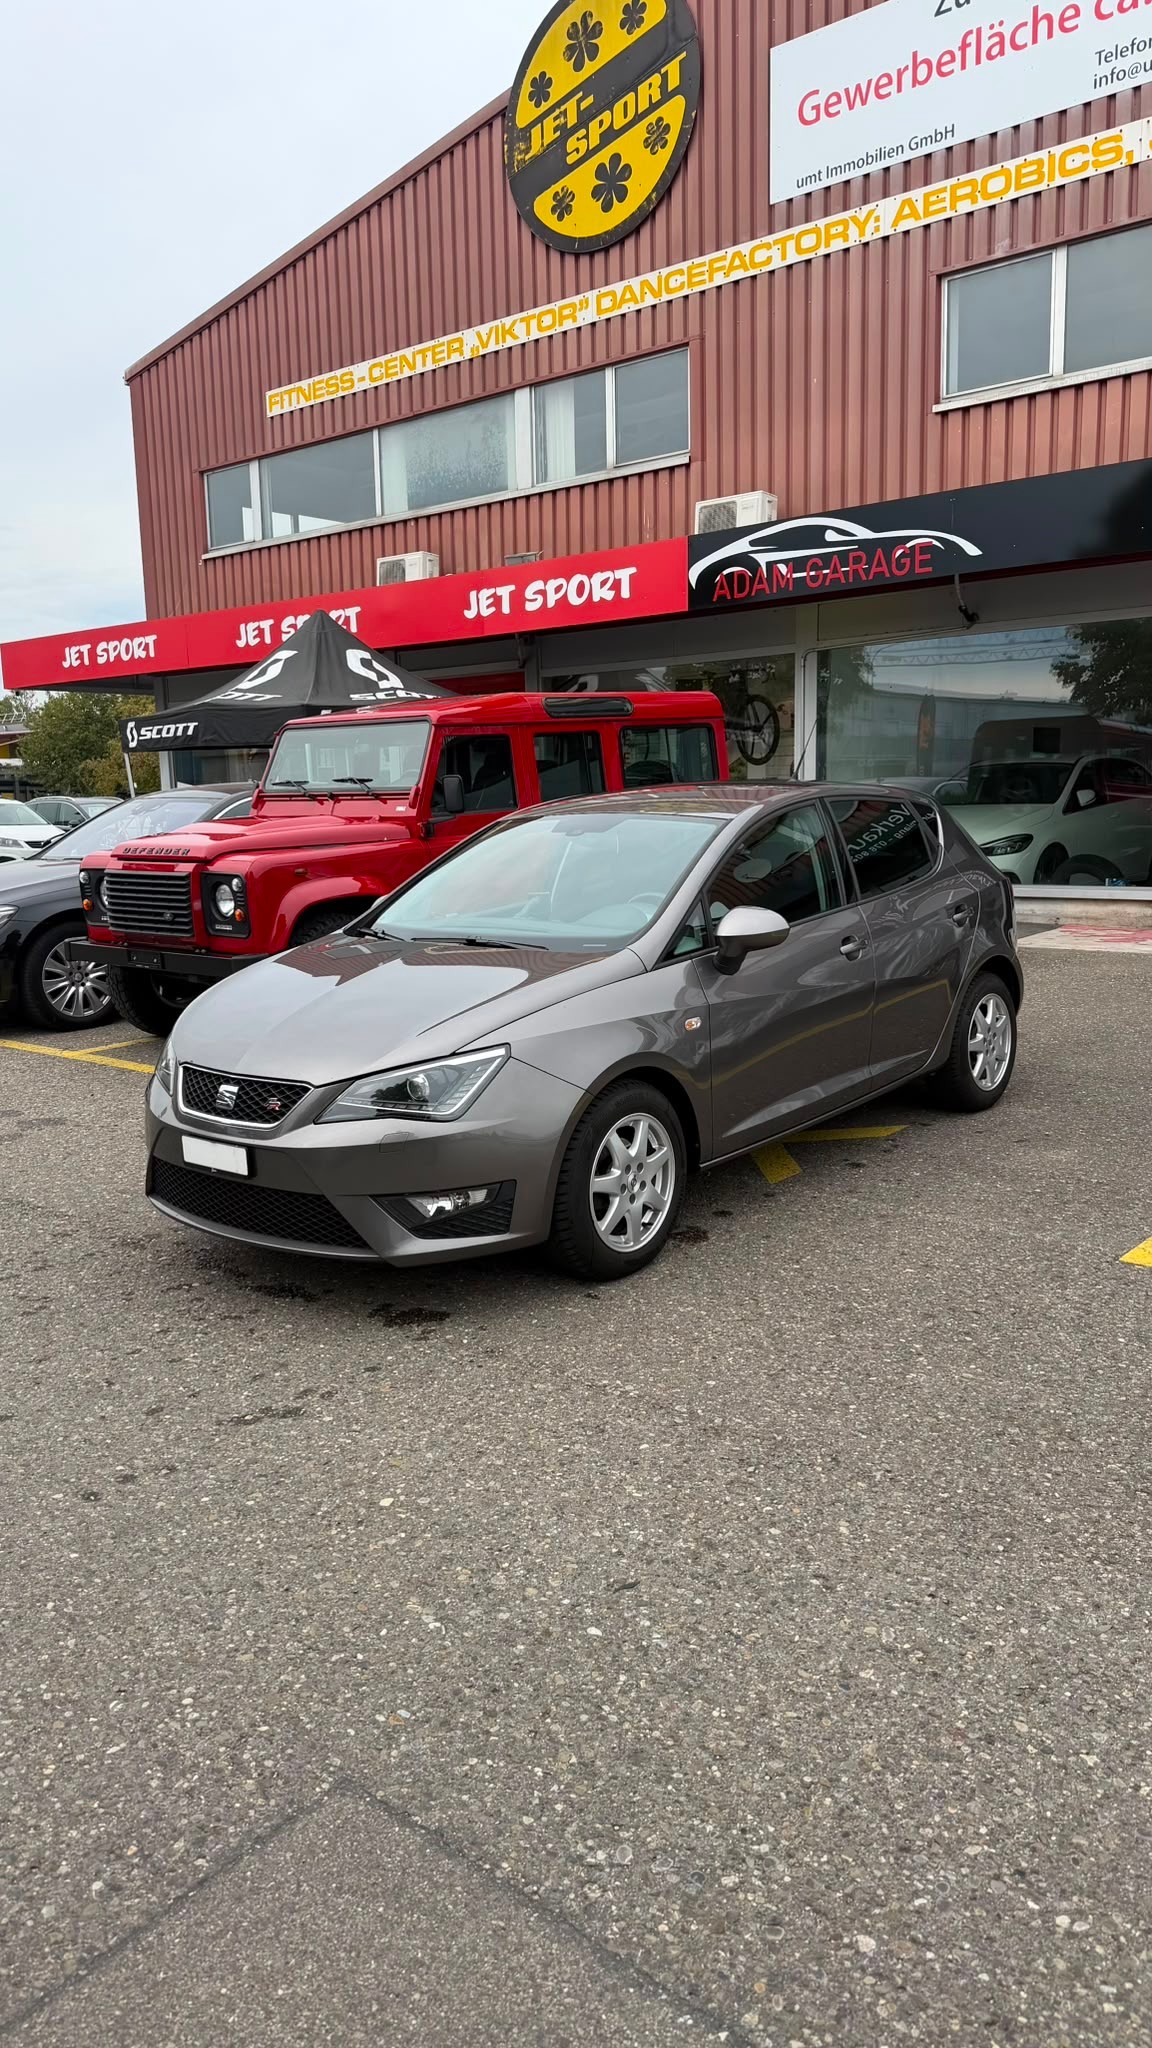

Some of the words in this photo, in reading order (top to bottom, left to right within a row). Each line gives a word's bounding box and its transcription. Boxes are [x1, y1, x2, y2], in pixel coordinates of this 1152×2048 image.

[797, 3, 1081, 126] Gewerbefläche
[525, 91, 594, 161] JET-
[566, 51, 687, 165] SPORT
[796, 168, 823, 189] umt
[826, 142, 905, 180] Immobilien
[908, 123, 956, 153] GmbH
[595, 207, 880, 317] DANCEFACTORY:
[891, 134, 1133, 228] AEROBICS,
[462, 583, 516, 619] JET
[524, 566, 637, 612] SPORT
[712, 562, 793, 602] ADAM
[805, 541, 934, 588] GARAGE
[62, 643, 91, 668] JET
[96, 635, 157, 664] SPORT
[235, 619, 275, 648] JET
[138, 721, 199, 740] SCOTT
[122, 847, 191, 856] DEFENDER
